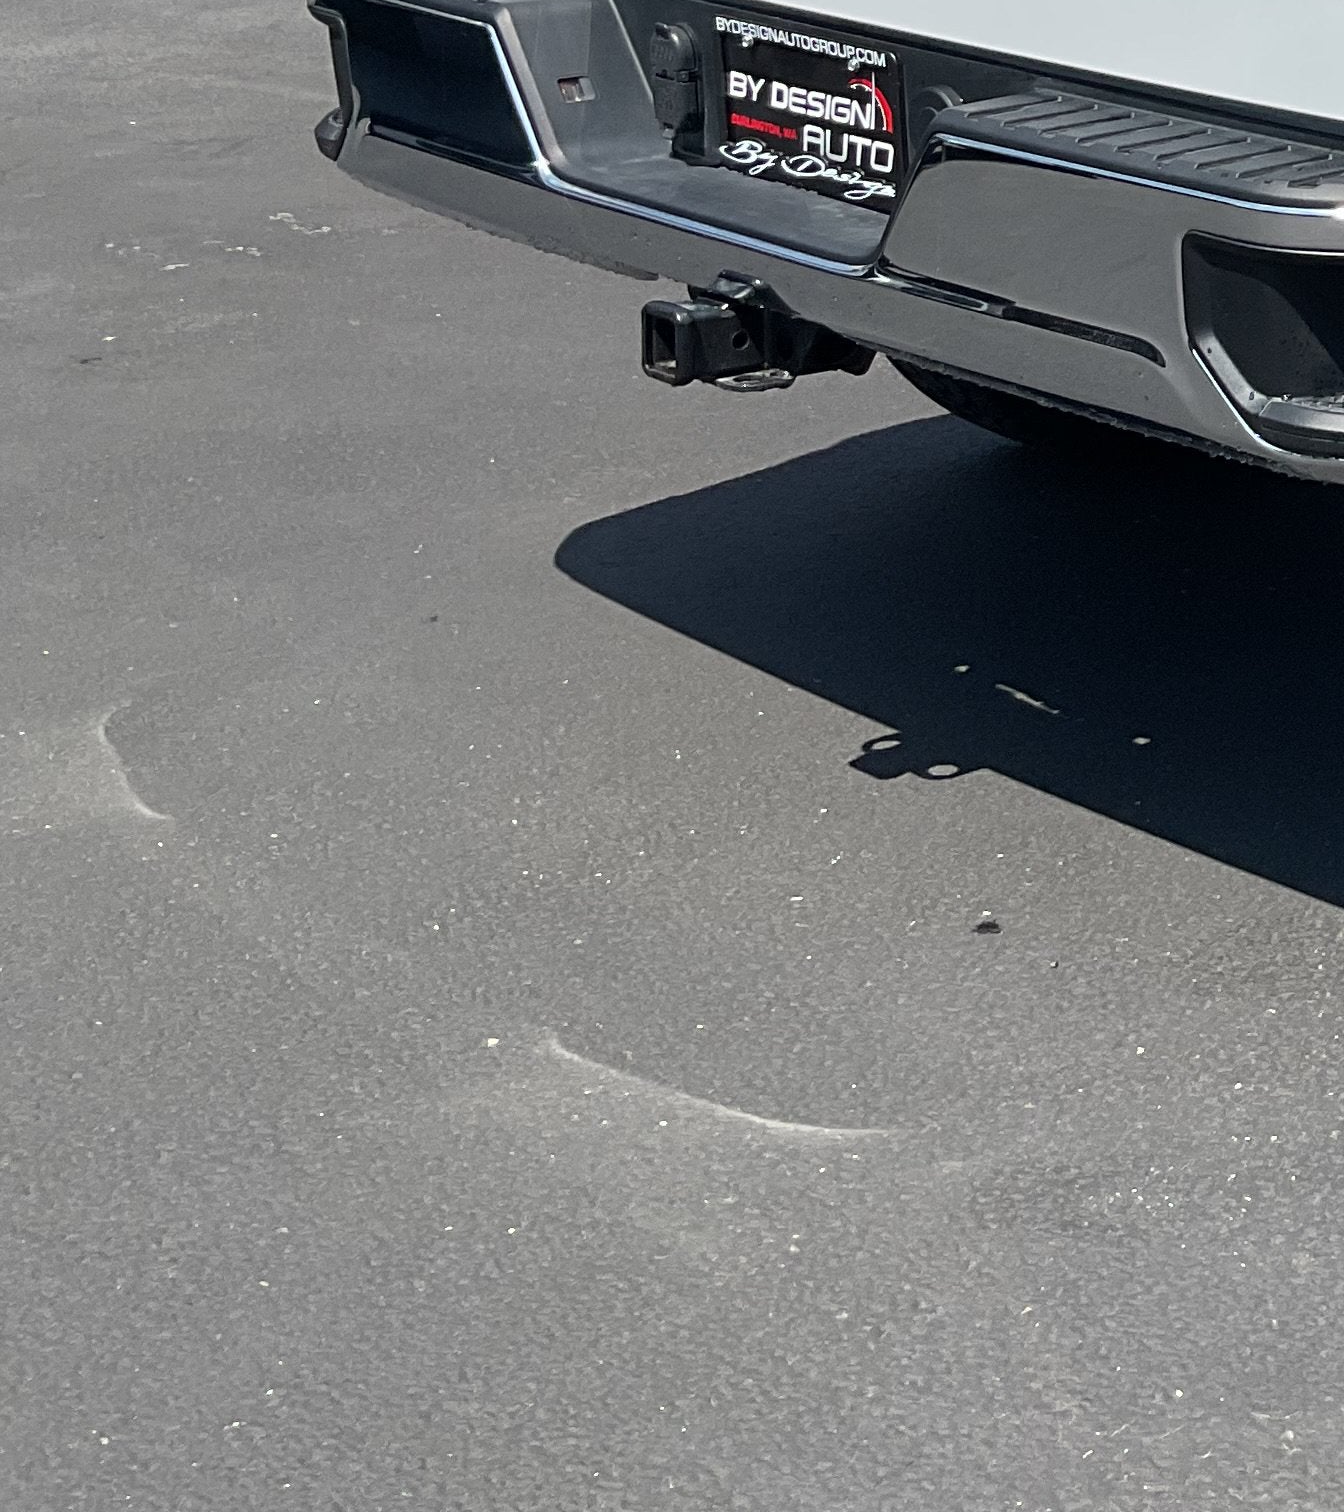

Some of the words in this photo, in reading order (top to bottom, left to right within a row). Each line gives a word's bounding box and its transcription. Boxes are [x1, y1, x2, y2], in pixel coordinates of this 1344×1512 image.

[715, 16, 887, 68] BYDESIGNAUTOGROUP.COM
[728, 70, 766, 102] BY
[770, 80, 873, 130] DESIGN
[719, 140, 779, 175] By
[802, 124, 895, 172] AUTO
